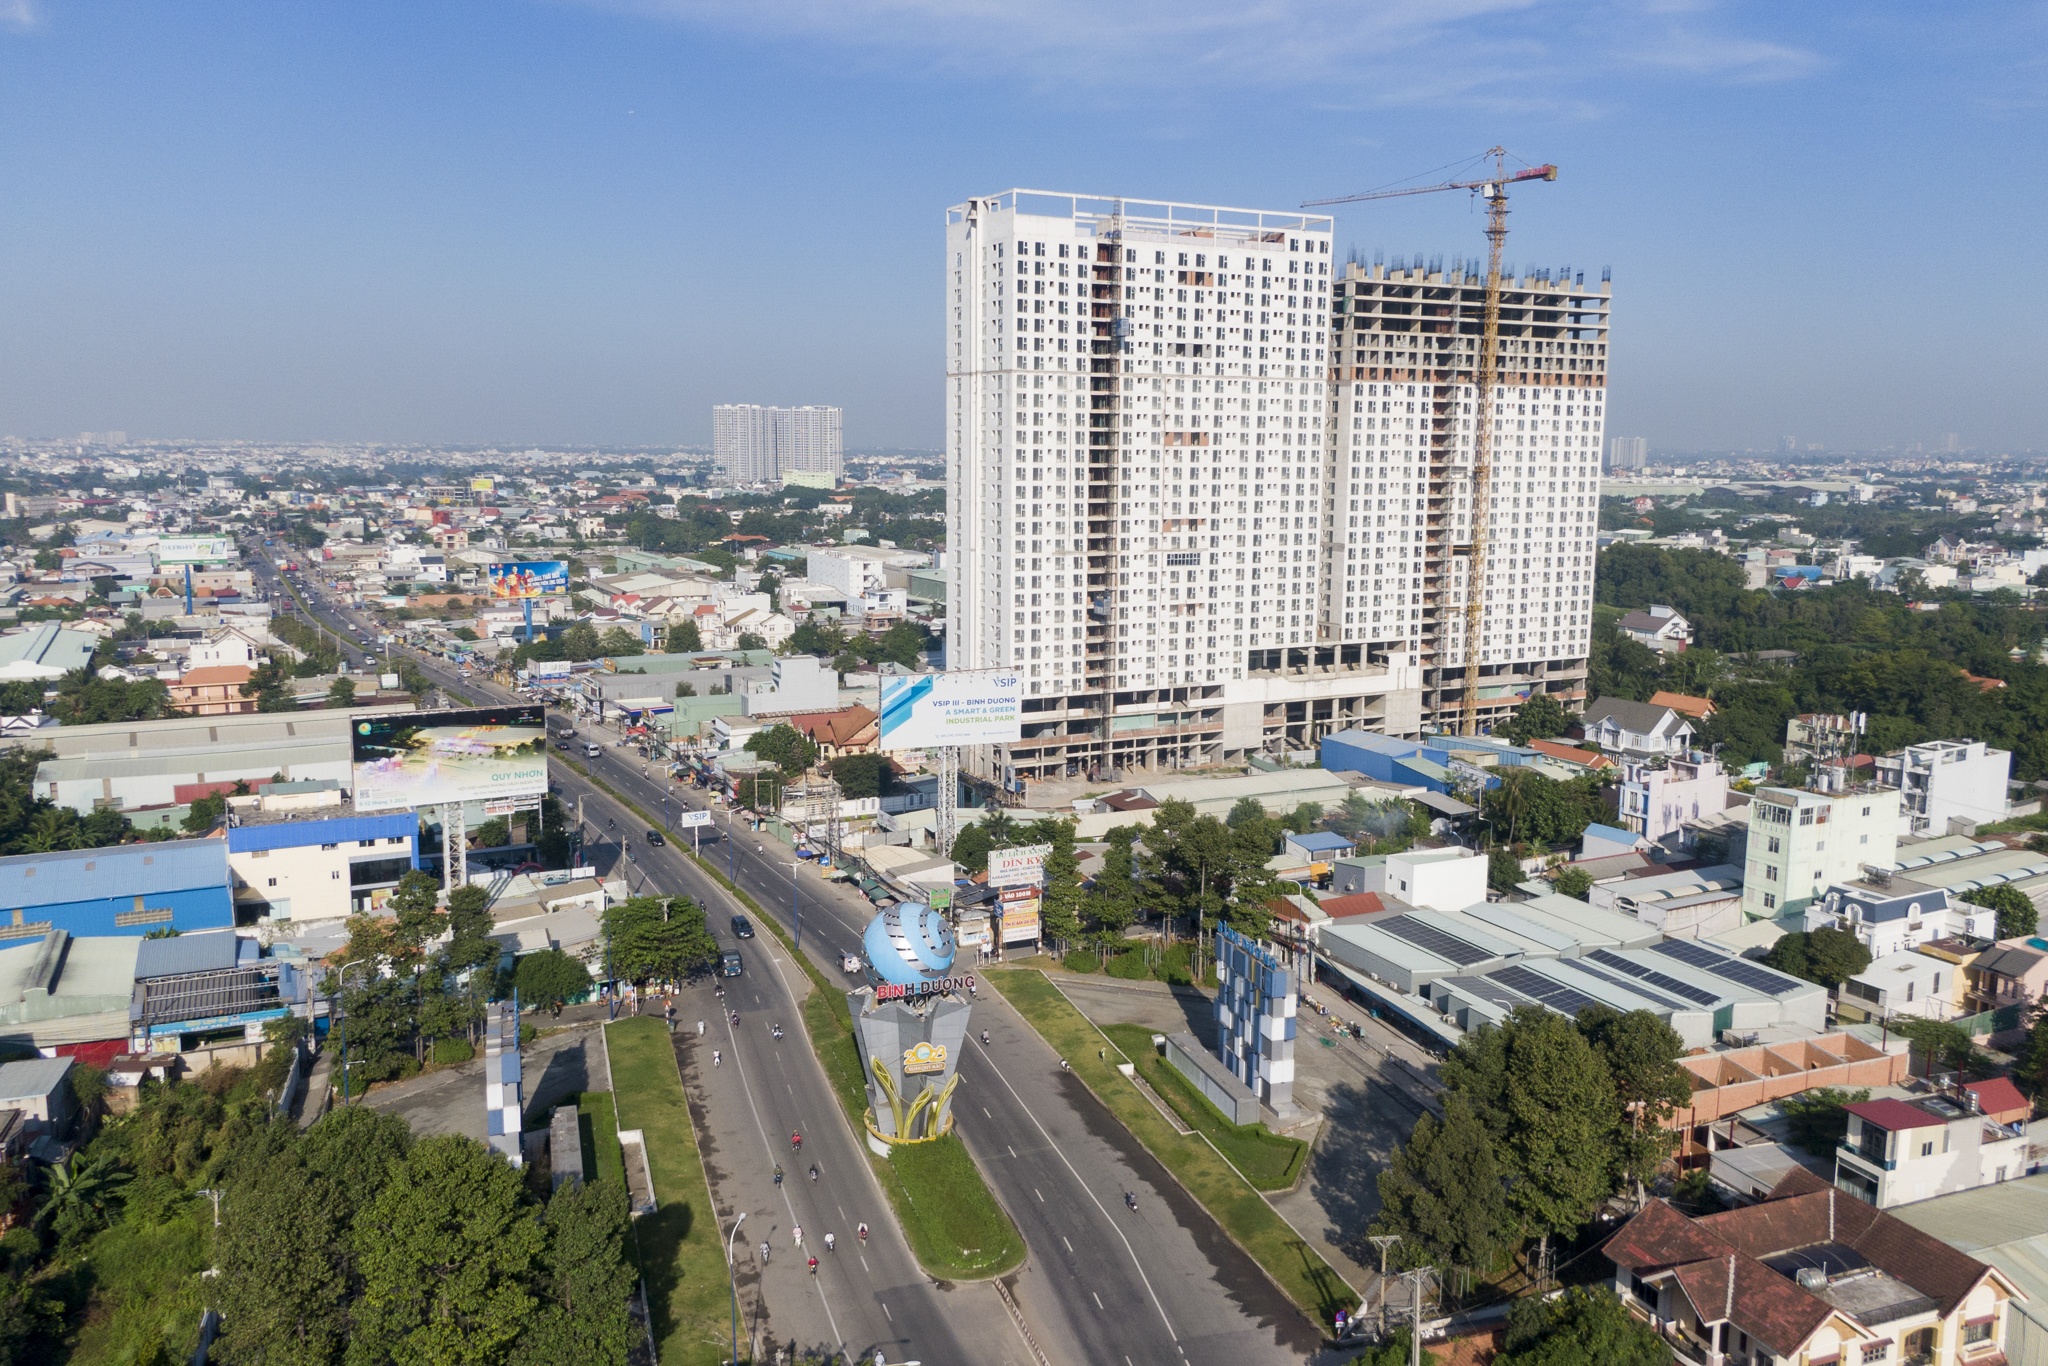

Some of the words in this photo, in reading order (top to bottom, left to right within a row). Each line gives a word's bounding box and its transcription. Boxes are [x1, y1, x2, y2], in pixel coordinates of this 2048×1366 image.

[993, 678, 1016, 687] VSIP
[946, 716, 992, 724] INDUSTRIAL
[492, 773, 511, 781] QUY
[515, 770, 543, 778] NHƠN
[1002, 858, 1023, 868] DÌN
[877, 982, 915, 999] BÌNH
[921, 976, 975, 993] DƯƠNG
[904, 1042, 947, 1065] 2023
